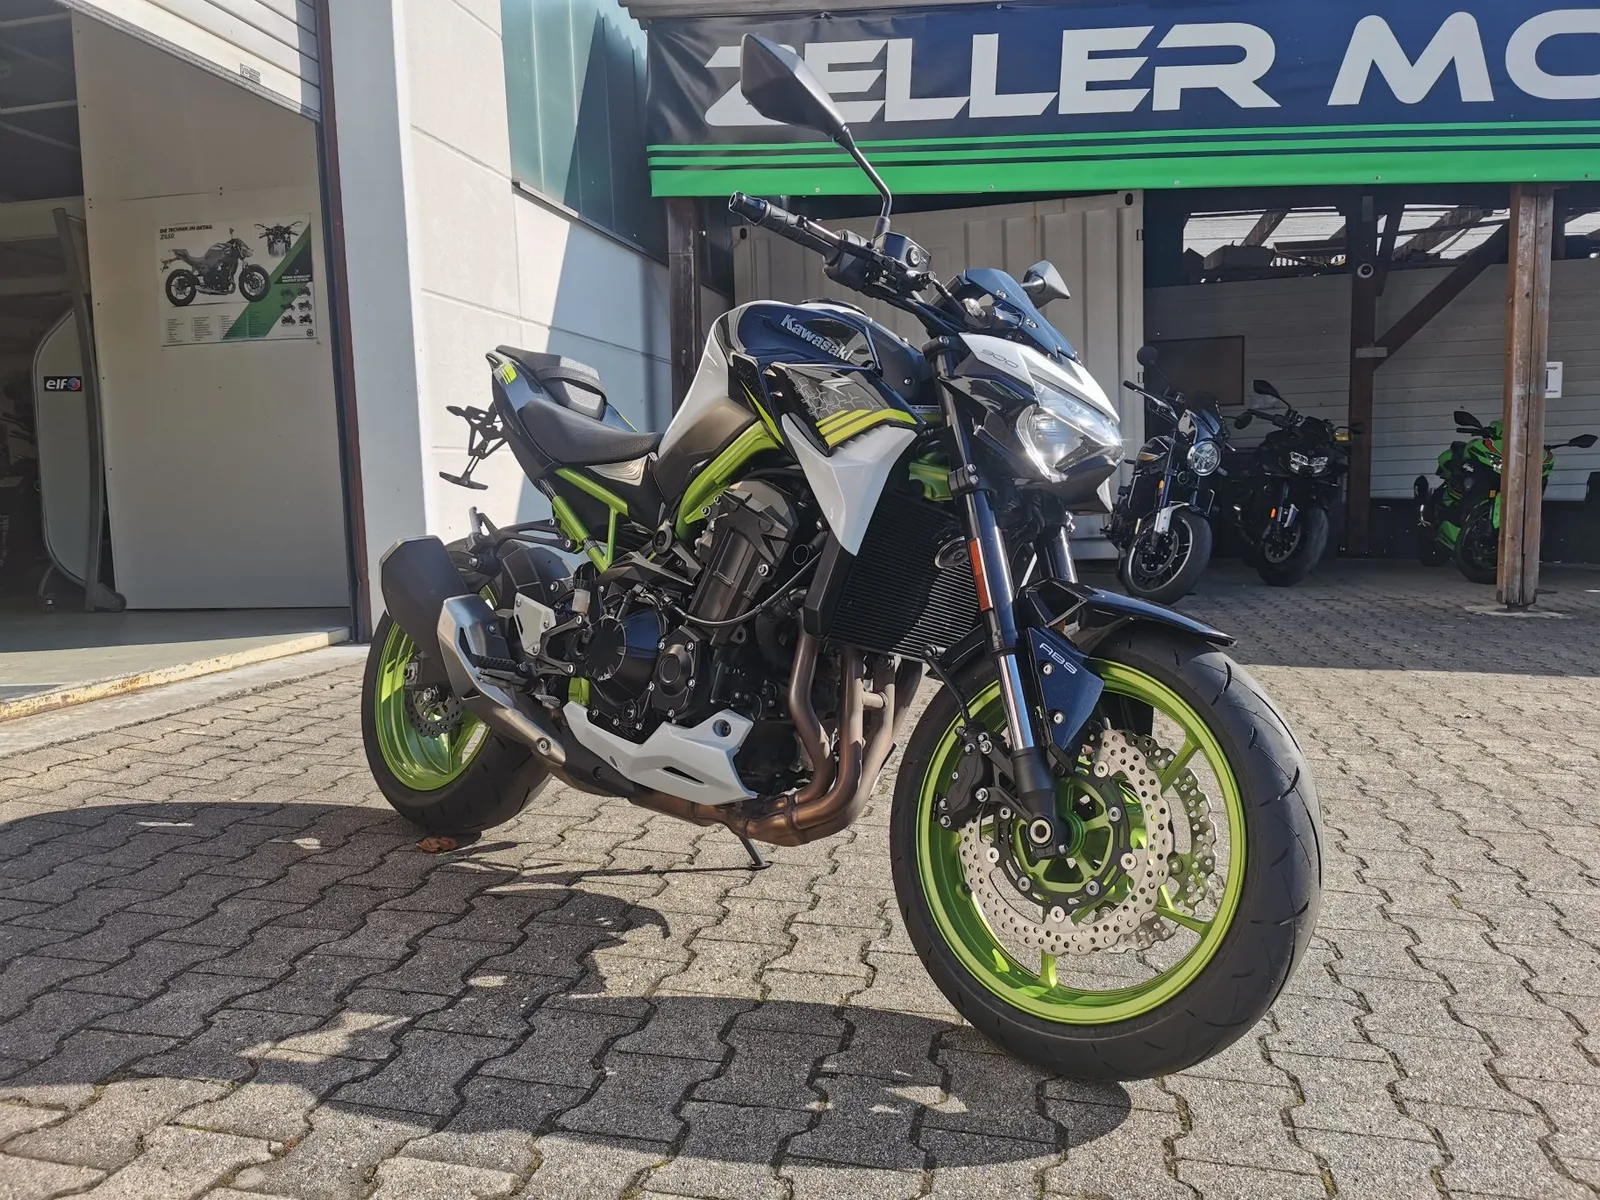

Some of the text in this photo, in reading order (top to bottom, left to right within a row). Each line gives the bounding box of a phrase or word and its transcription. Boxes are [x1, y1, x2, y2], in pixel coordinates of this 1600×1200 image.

[781, 314, 855, 362] Kawasaki
[981, 348, 1019, 369] 900
[45, 378, 68, 390] elf
[1039, 642, 1078, 675] ABS
